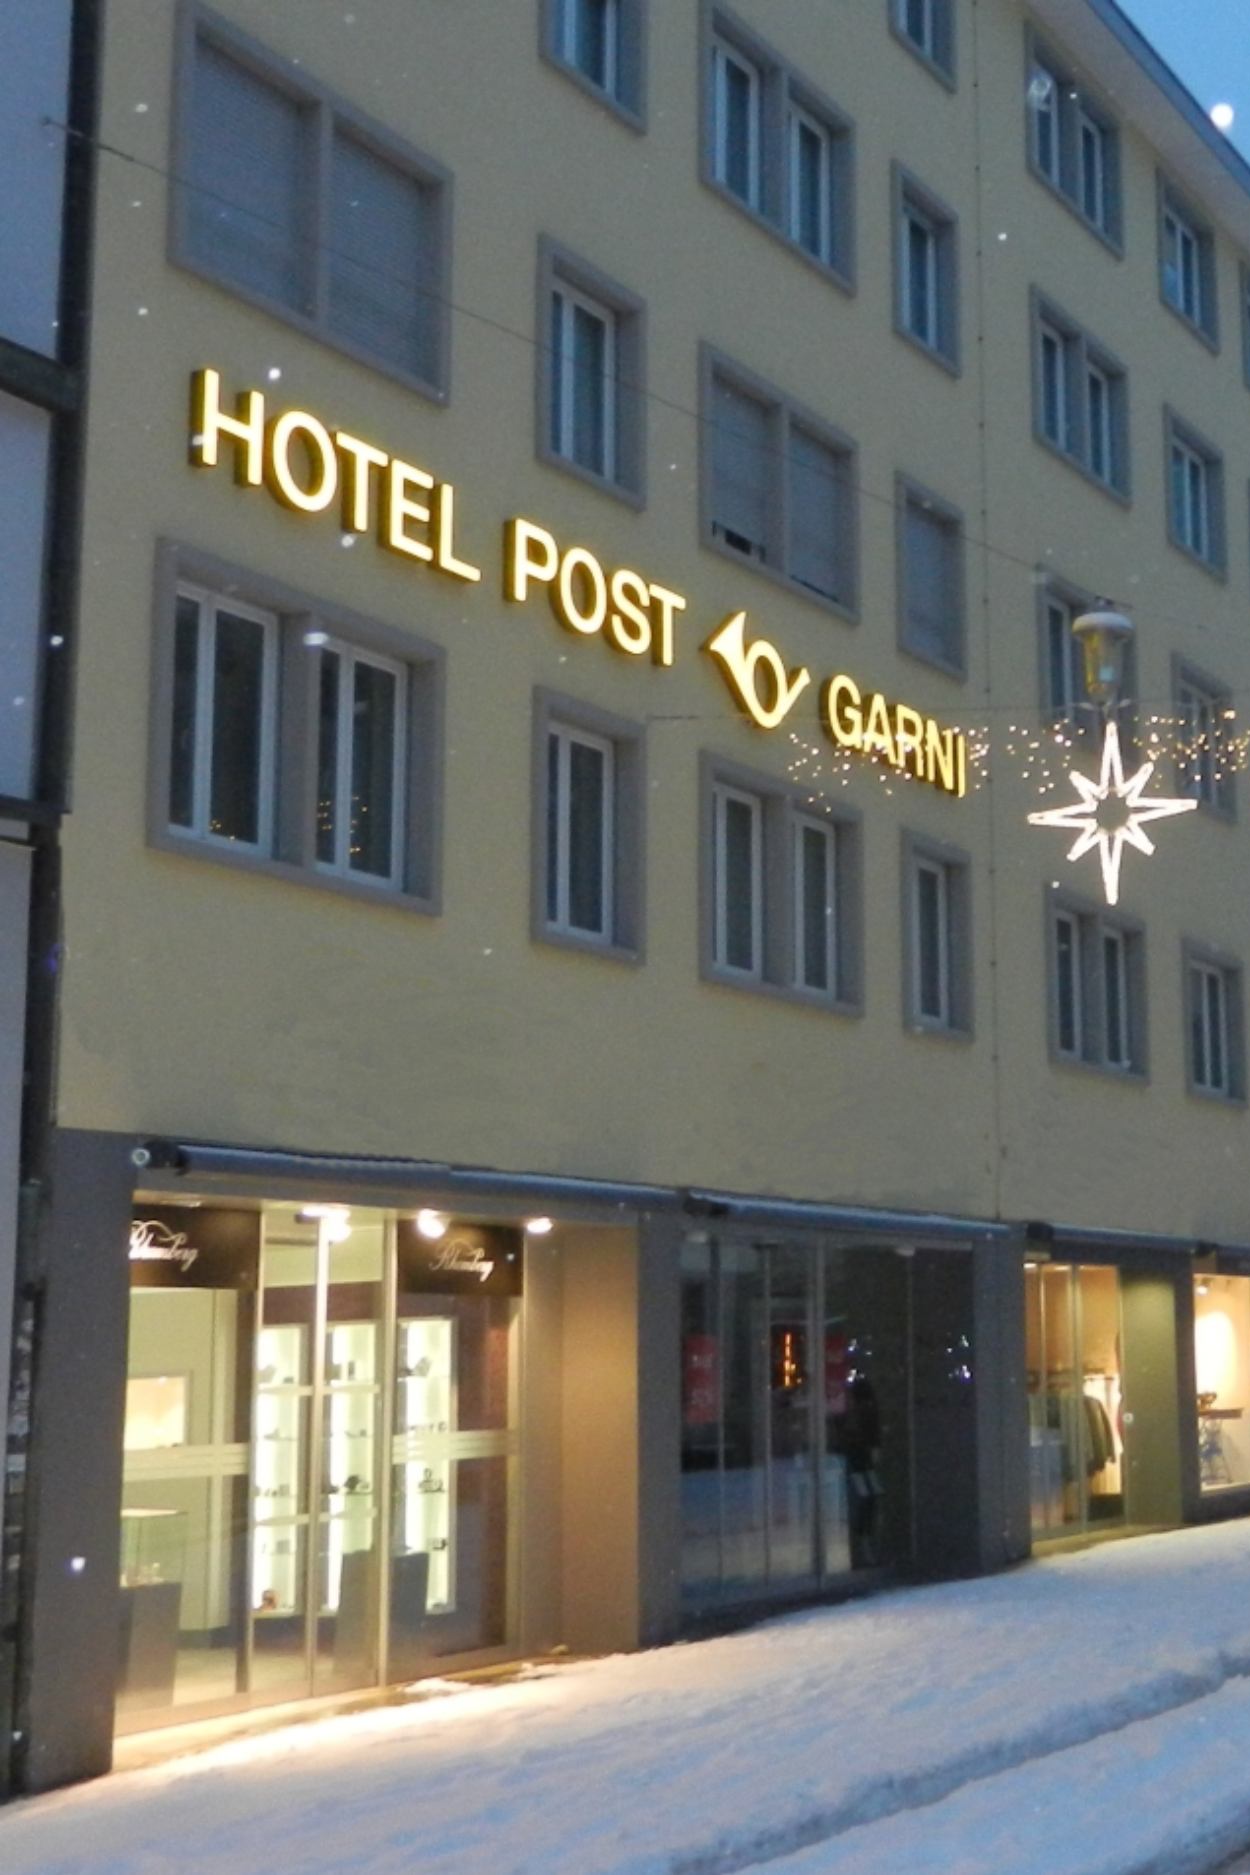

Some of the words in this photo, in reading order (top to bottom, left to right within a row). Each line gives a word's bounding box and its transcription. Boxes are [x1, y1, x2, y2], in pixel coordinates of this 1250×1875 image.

[192, 367, 482, 583] HOTEL
[506, 517, 687, 667] POST
[823, 674, 966, 798] GARNI
